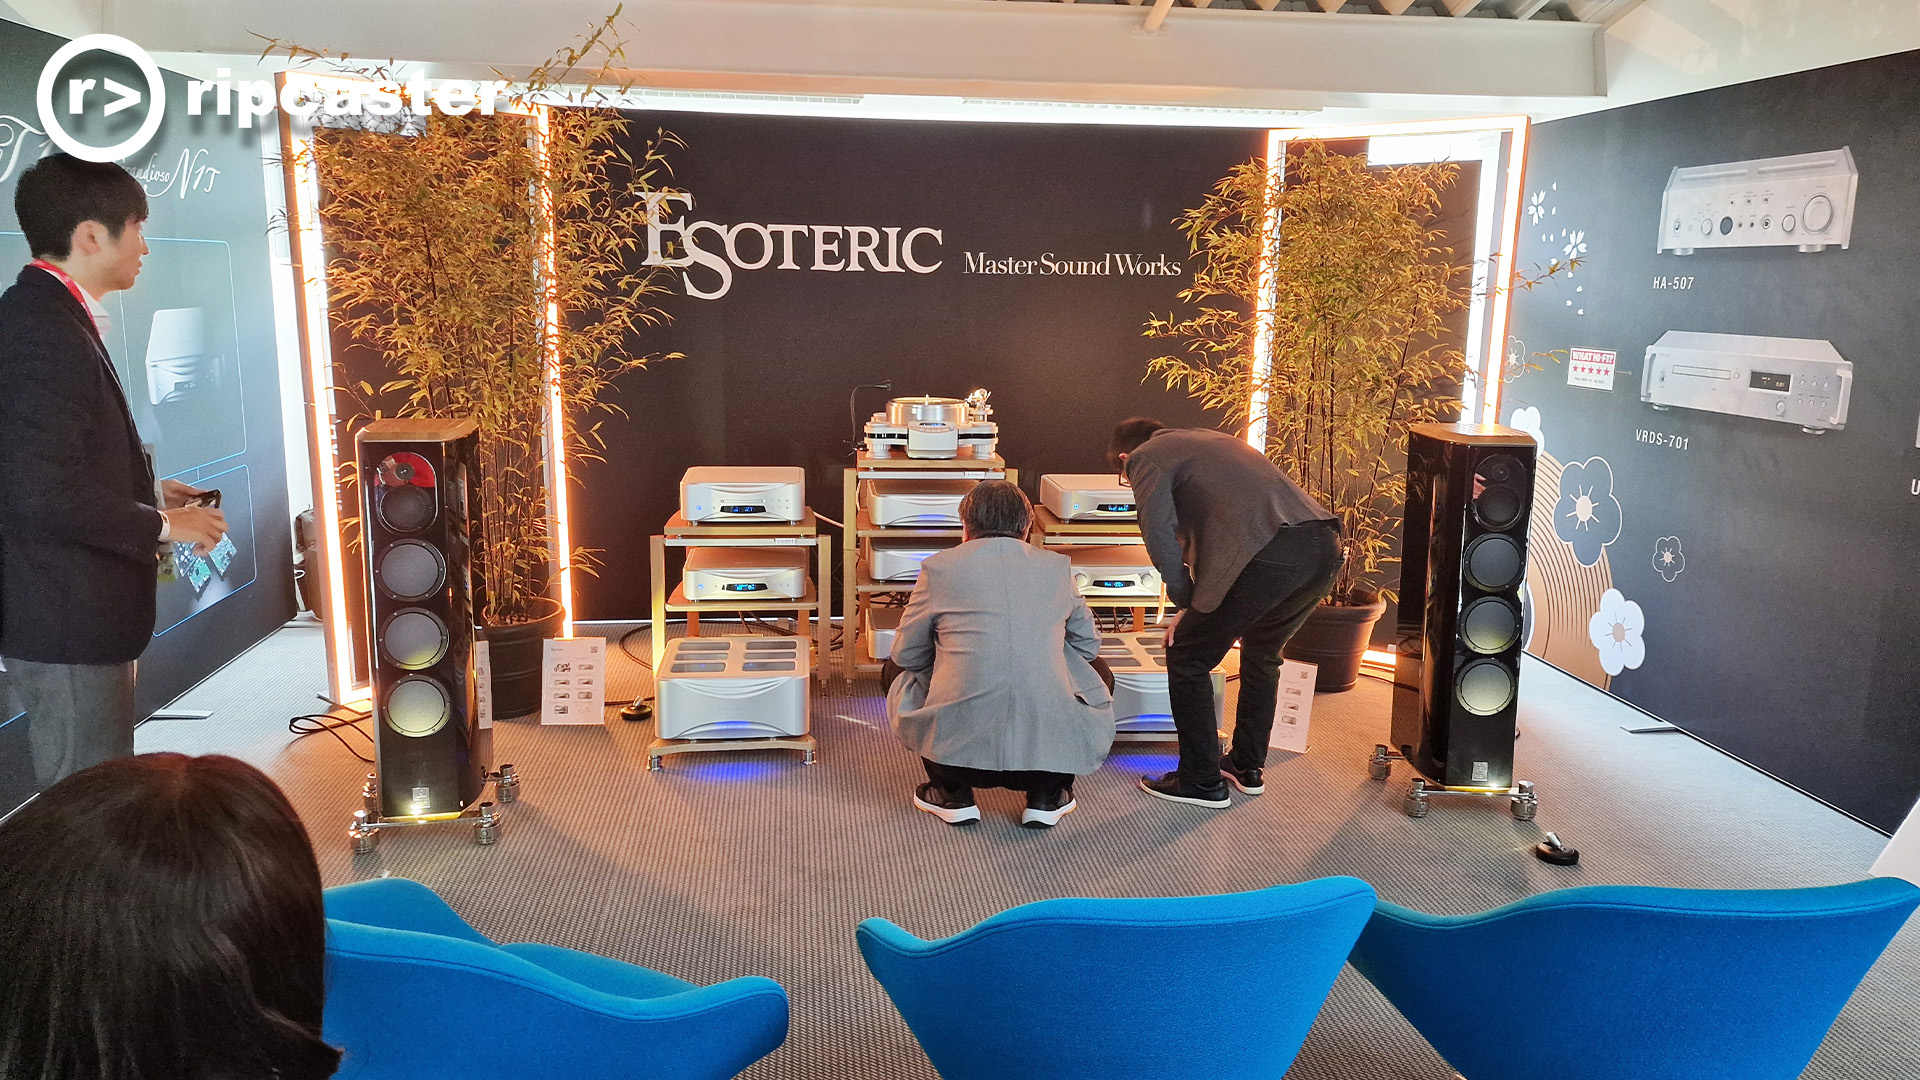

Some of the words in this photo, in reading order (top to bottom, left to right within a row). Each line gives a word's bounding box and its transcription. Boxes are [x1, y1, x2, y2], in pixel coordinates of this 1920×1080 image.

[634, 191, 944, 300] ESOTERIC
[963, 251, 1037, 276] Master
[1039, 252, 1111, 277] Sound
[1115, 253, 1182, 277] Works
[1652, 276, 1695, 291] HA-507
[1572, 351, 1593, 361] WHAT
[1635, 428, 1690, 451] VRDS-701
